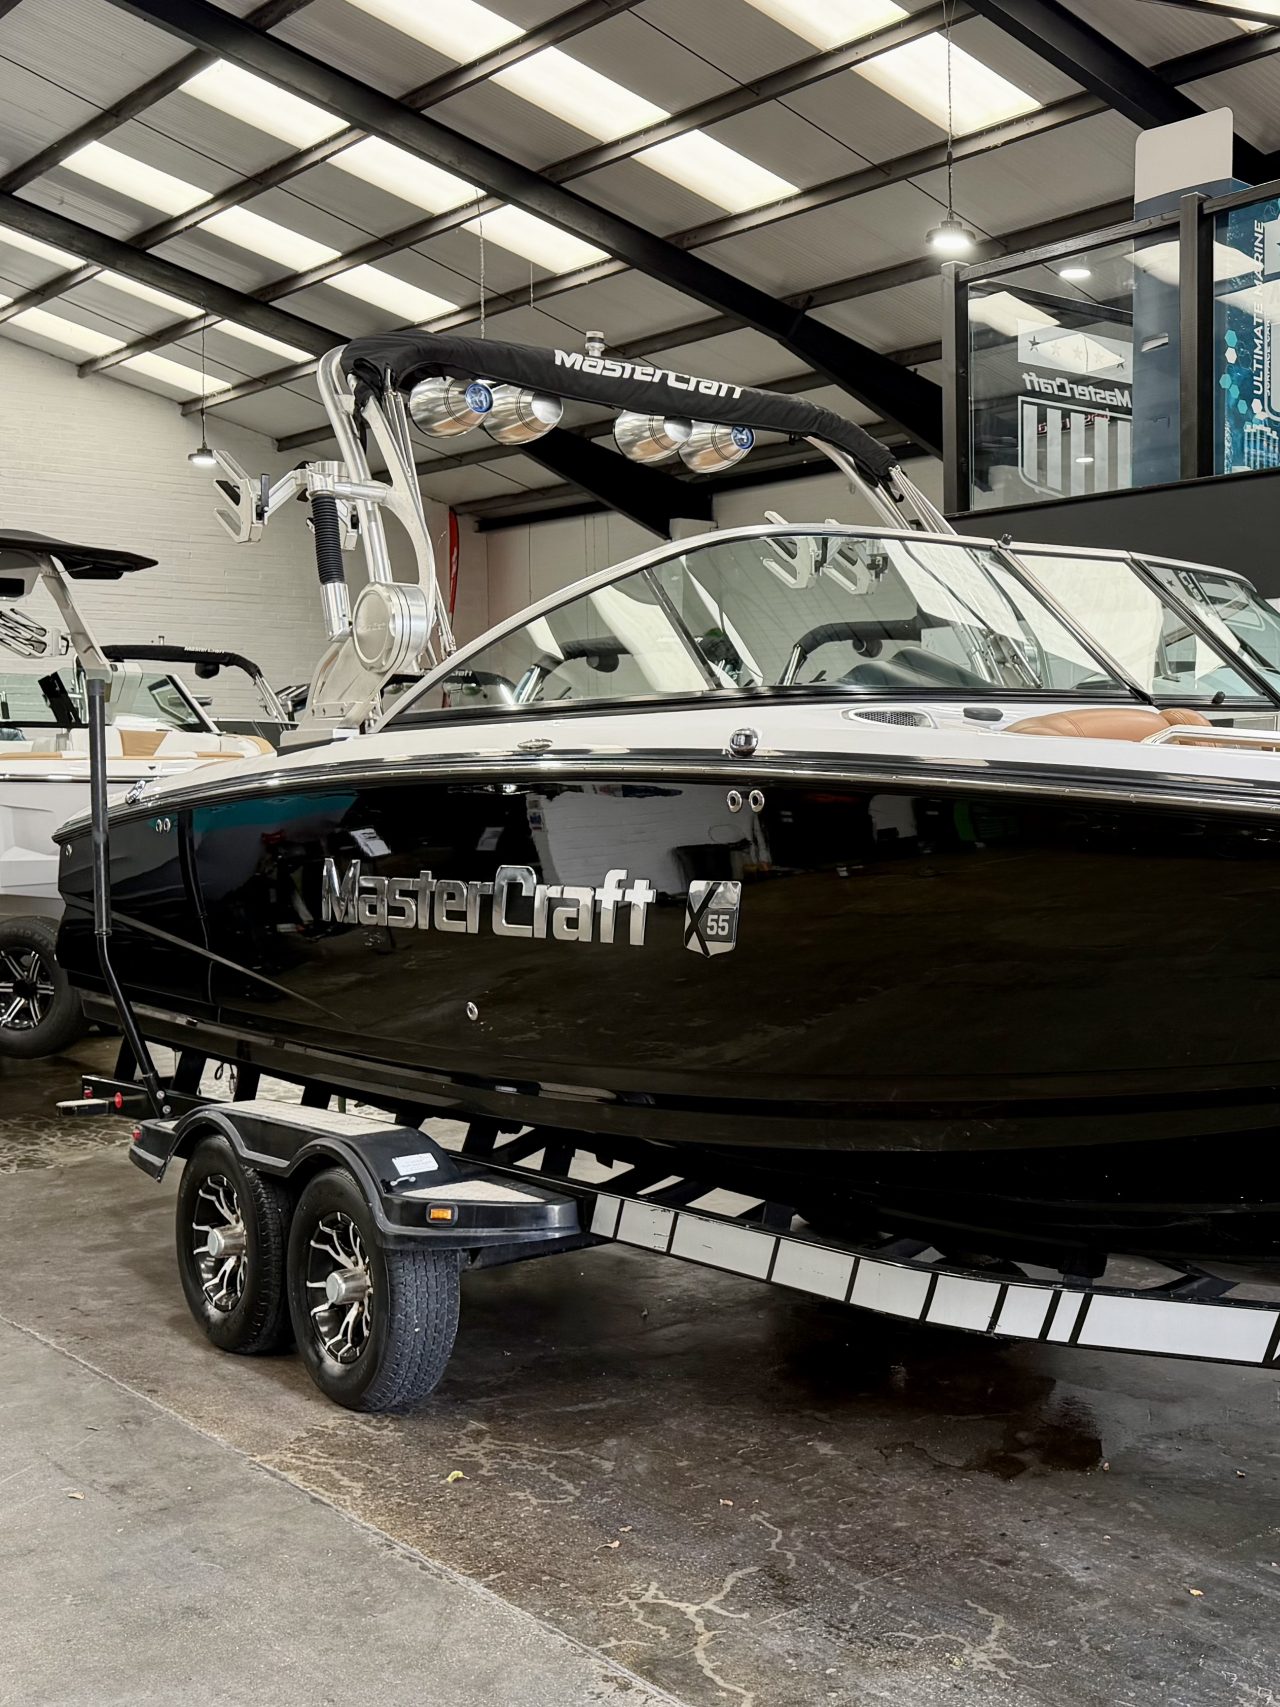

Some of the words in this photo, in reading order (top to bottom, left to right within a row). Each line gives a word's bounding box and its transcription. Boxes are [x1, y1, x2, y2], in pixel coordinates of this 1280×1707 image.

[1253, 219, 1265, 297] MARINE
[1252, 301, 1264, 395] ULTIMATE
[321, 858, 657, 946] MasterCraft
